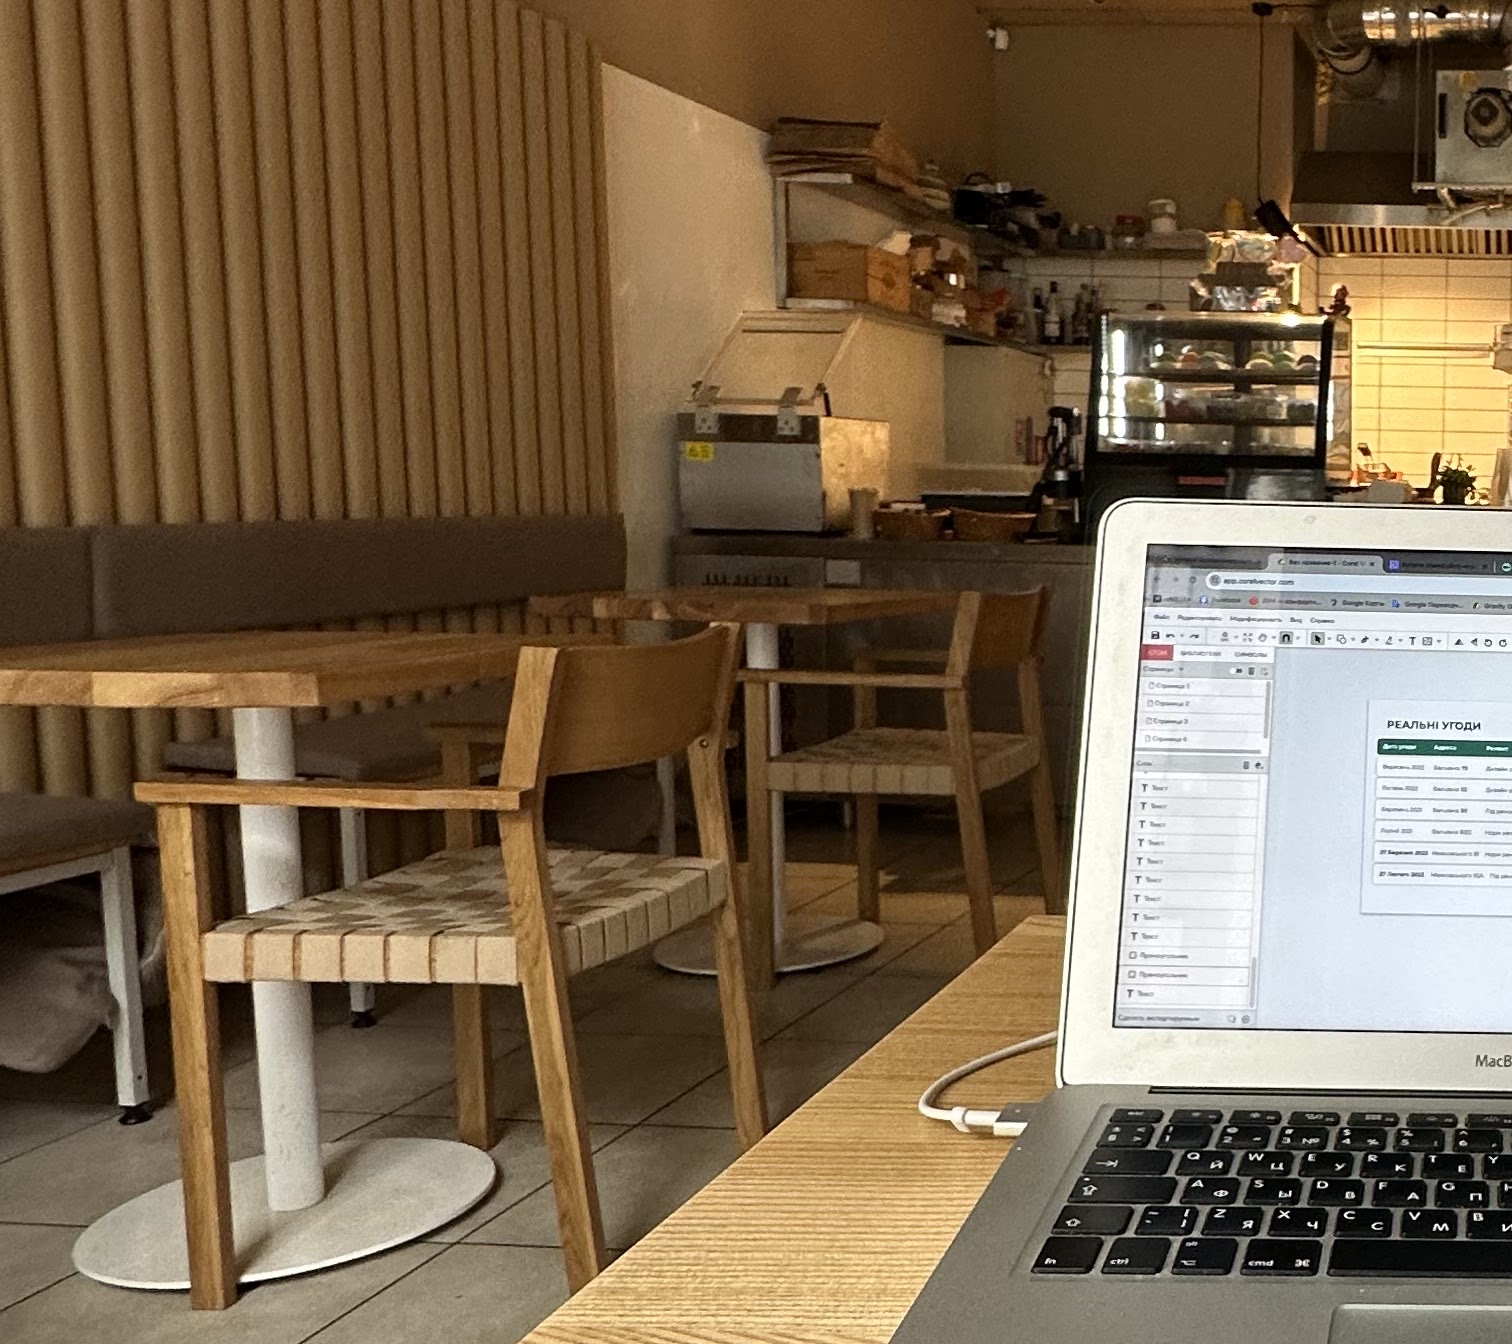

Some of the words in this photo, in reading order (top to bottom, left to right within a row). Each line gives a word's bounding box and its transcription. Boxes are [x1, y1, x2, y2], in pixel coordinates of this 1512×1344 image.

[1387, 720, 1439, 729] РЕАЛЬНІ
[1441, 721, 1482, 732] УГОДИ
[1249, 1153, 1264, 1161] W
[1255, 1180, 1264, 1188] S
[1317, 1181, 1328, 1189] D
[1214, 1209, 1226, 1218] Z
[1278, 1210, 1290, 1218] X
[1344, 1211, 1355, 1219] C
[1409, 1212, 1420, 1220] V
[1473, 1213, 1483, 1221] B
